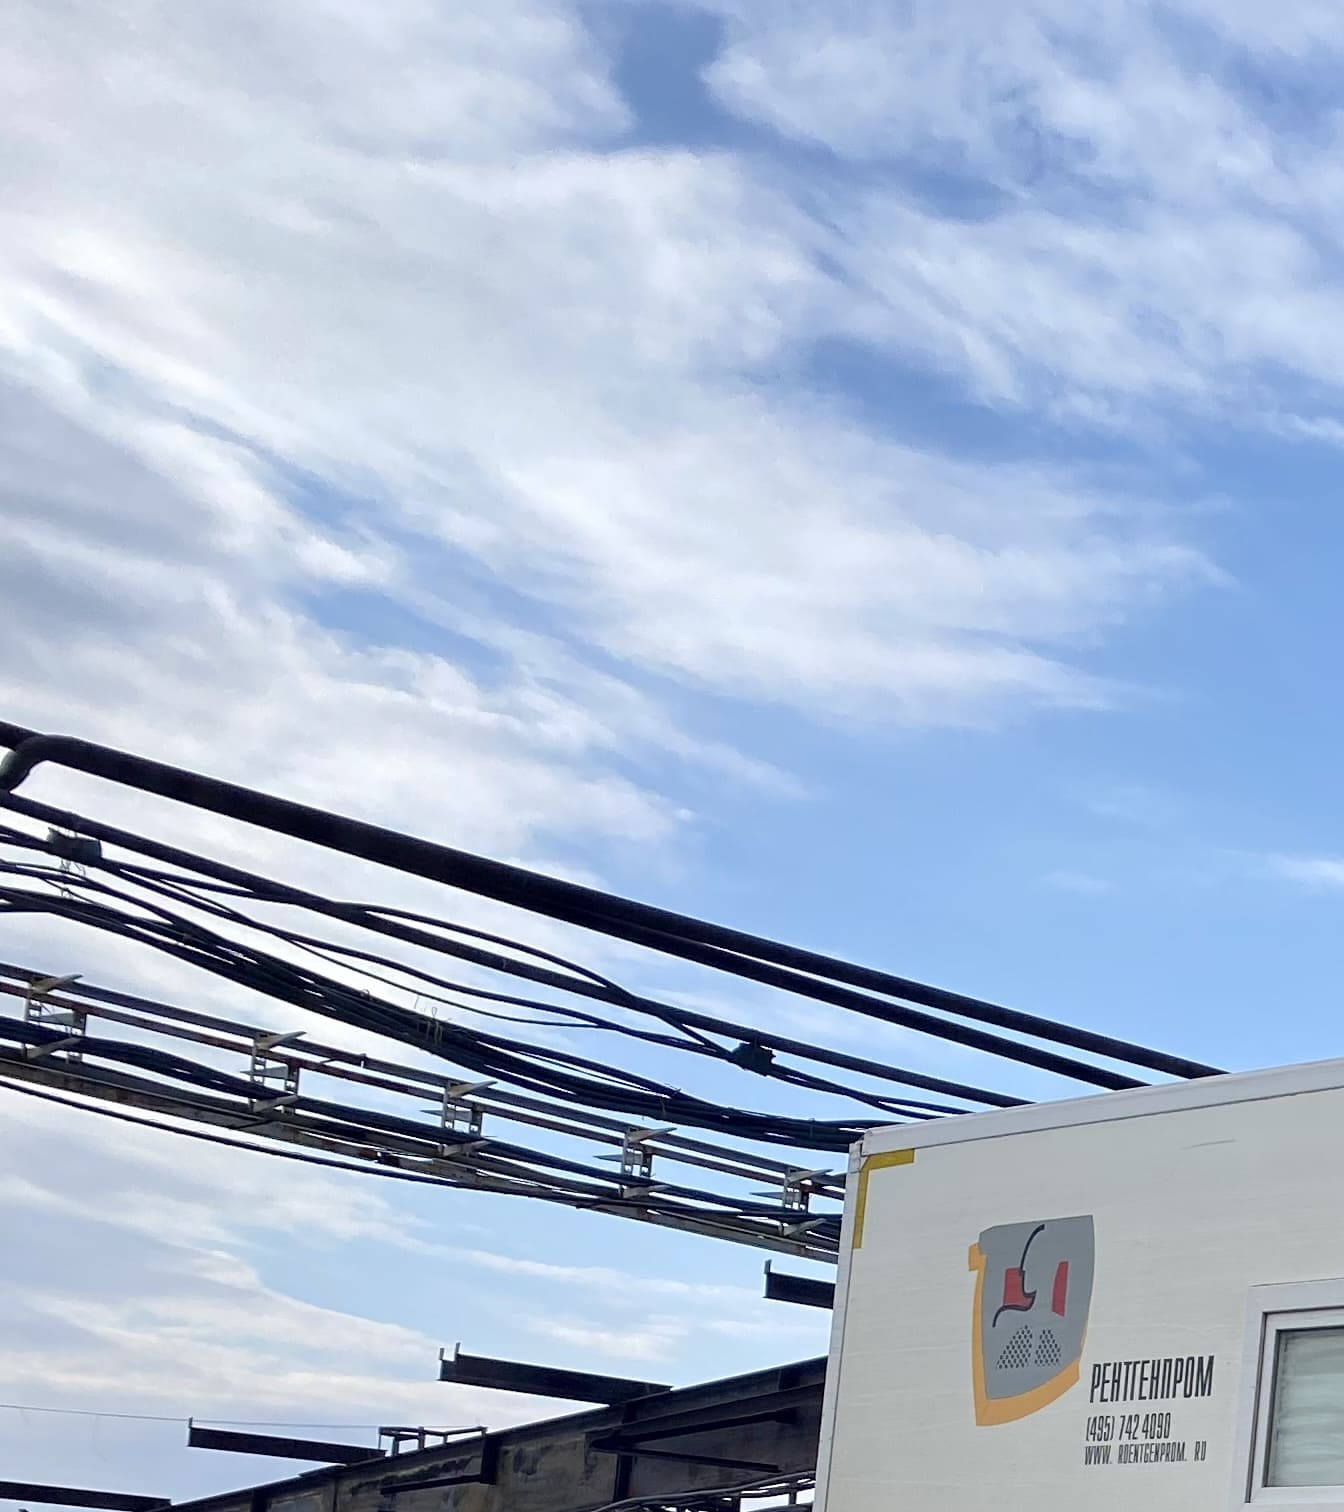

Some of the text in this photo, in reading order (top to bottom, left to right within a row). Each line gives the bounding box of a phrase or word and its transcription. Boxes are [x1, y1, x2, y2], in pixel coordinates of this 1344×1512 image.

[1090, 1355, 1215, 1403] РЕНТГЕНПРОМ
[1086, 1412, 1172, 1442] (495) 742 4090
